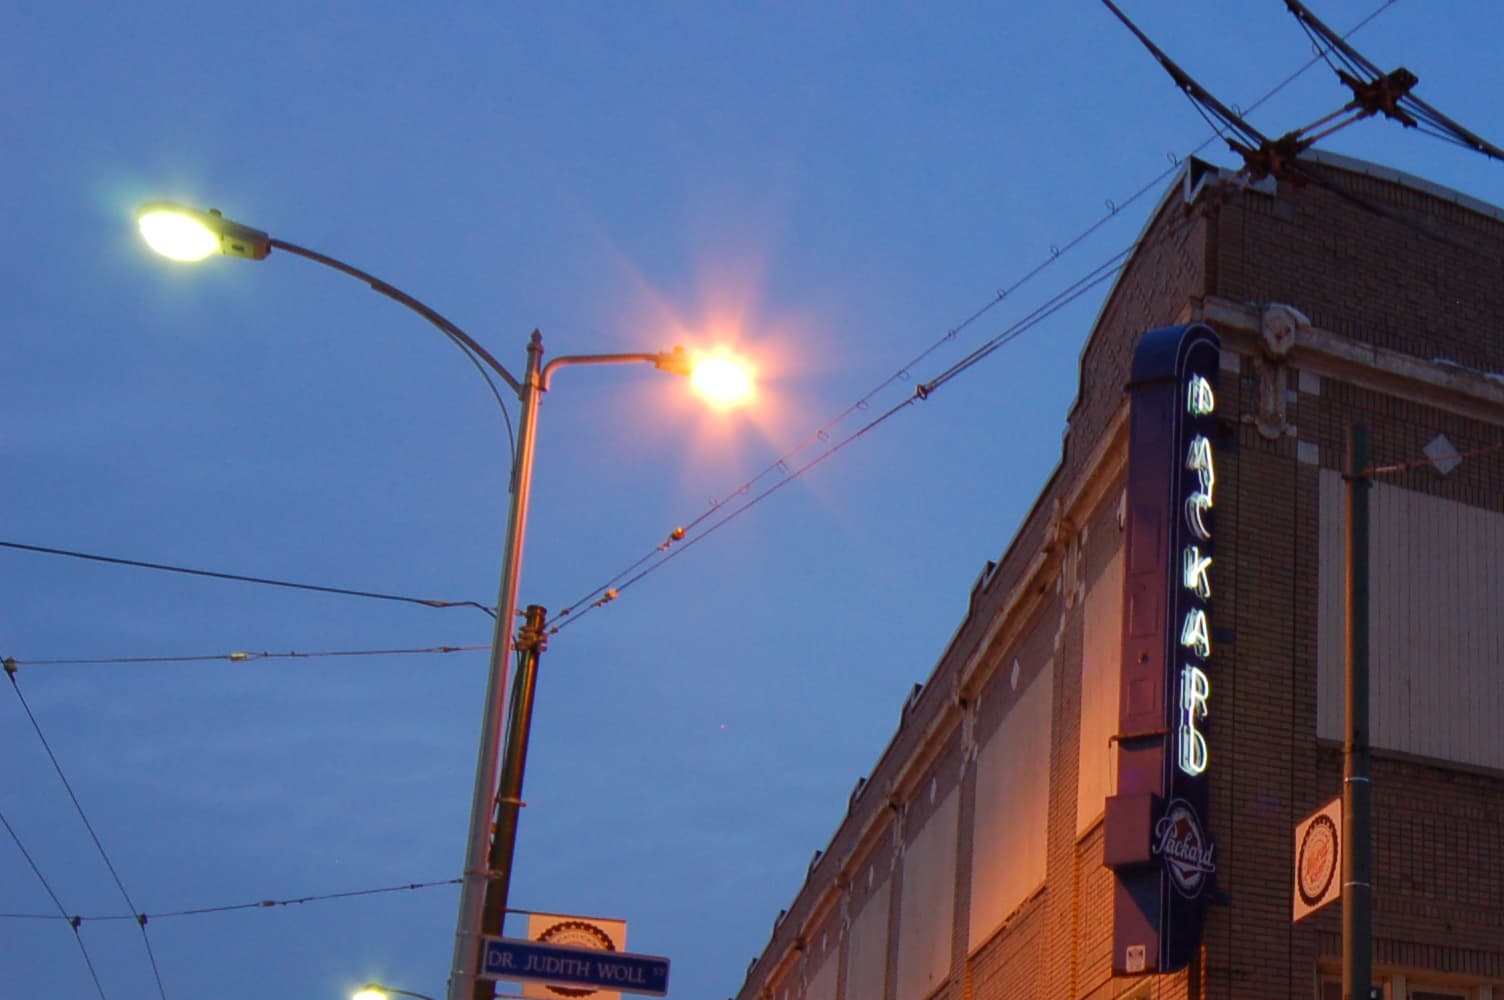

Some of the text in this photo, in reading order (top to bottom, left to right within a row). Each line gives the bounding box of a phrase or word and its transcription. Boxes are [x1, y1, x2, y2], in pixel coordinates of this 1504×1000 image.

[1178, 371, 1216, 777] PACKARD
[1151, 816, 1215, 872] Packard
[486, 949, 517, 970] DR.
[525, 954, 591, 978] JUDITH
[597, 961, 648, 984] WOLL
